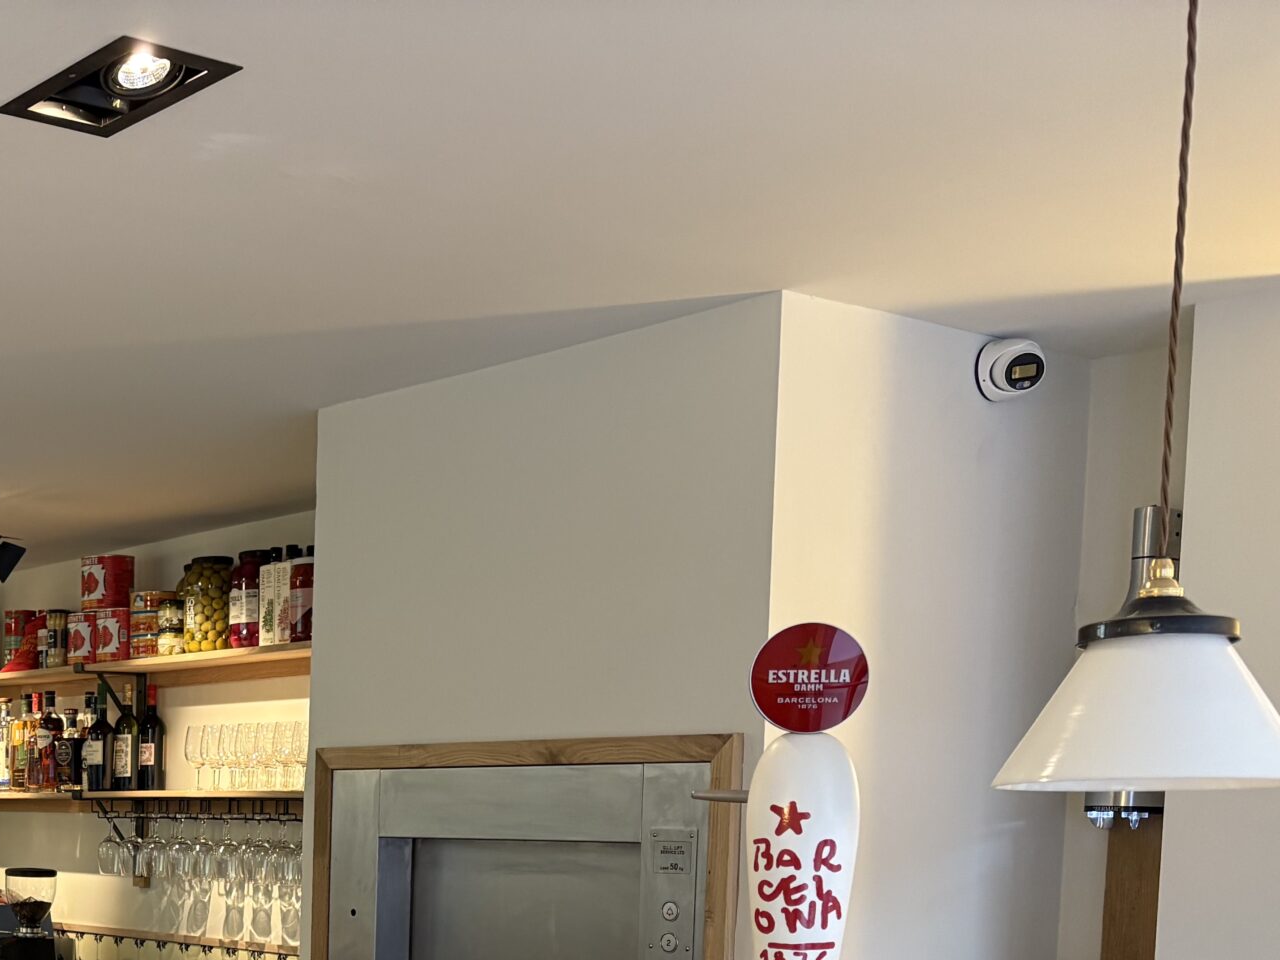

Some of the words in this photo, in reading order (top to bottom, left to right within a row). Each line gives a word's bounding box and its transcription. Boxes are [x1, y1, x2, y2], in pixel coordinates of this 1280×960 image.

[768, 669, 851, 683] ESTRELLA
[794, 684, 823, 692] DAMM
[753, 838, 841, 872] BAR
[666, 939, 672, 947] 2
